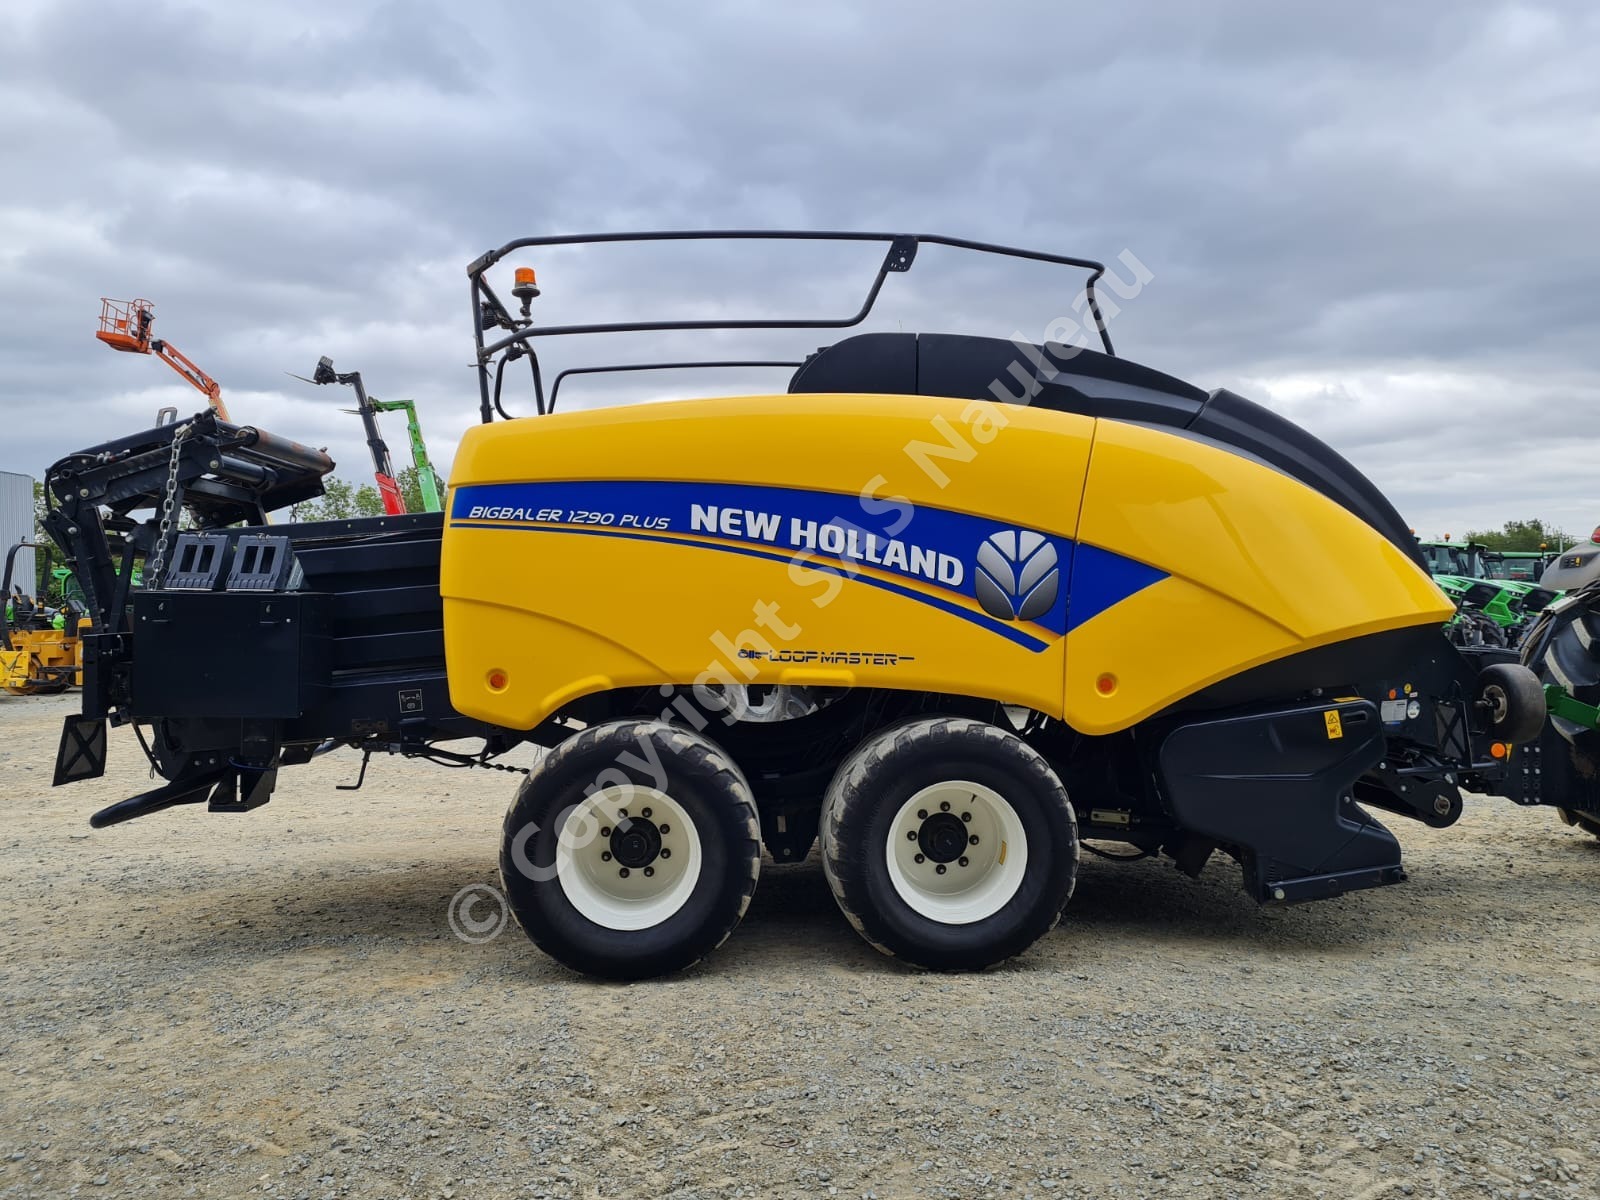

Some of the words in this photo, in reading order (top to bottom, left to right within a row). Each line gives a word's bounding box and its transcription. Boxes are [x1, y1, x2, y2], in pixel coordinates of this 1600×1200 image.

[469, 506, 562, 522] BIGBALER
[567, 510, 615, 525] 1290
[619, 515, 671, 530] PLUS
[690, 503, 781, 541] NEW
[790, 518, 964, 587] HOLLAND
